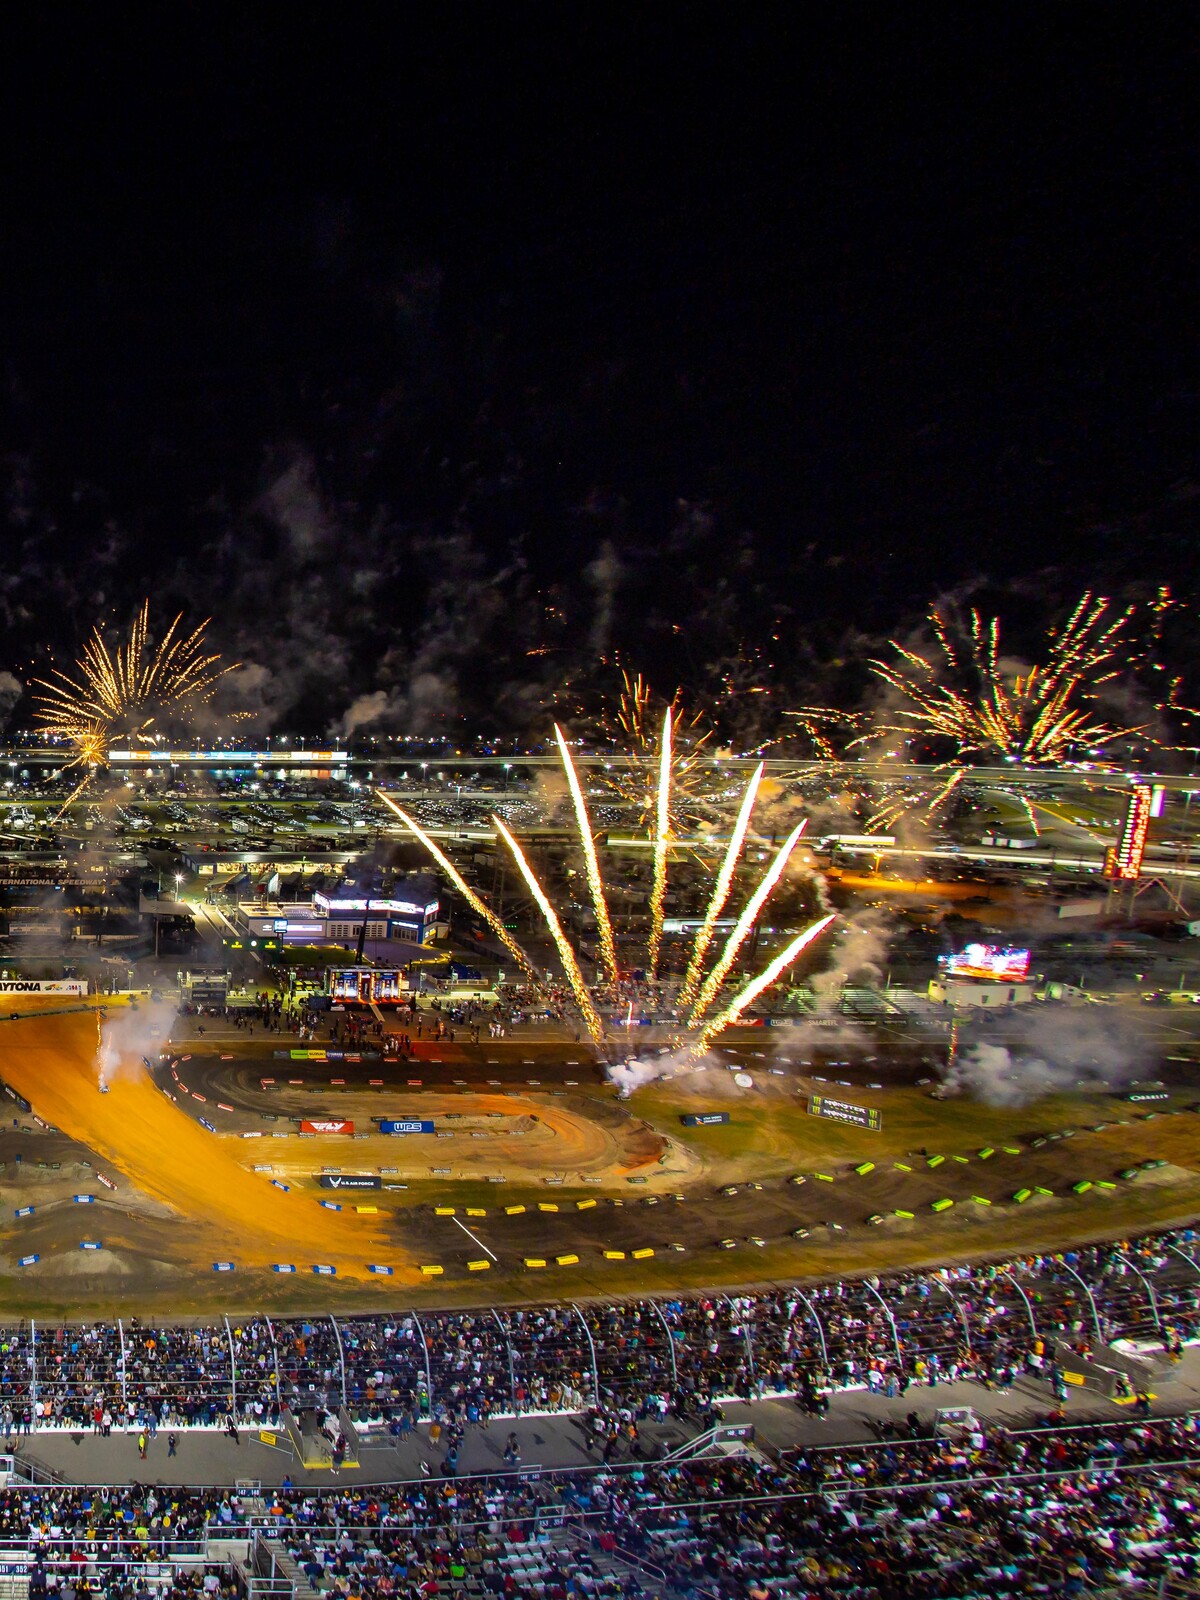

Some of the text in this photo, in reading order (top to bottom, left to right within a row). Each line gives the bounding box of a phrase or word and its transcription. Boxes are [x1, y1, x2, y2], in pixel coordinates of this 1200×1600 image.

[823, 1099, 867, 1114] MONSTER
[822, 1109, 866, 1124] MONSTER
[310, 1122, 345, 1130] FLY
[394, 1122, 422, 1132] WPS
[15, 1564, 28, 1573] 352
